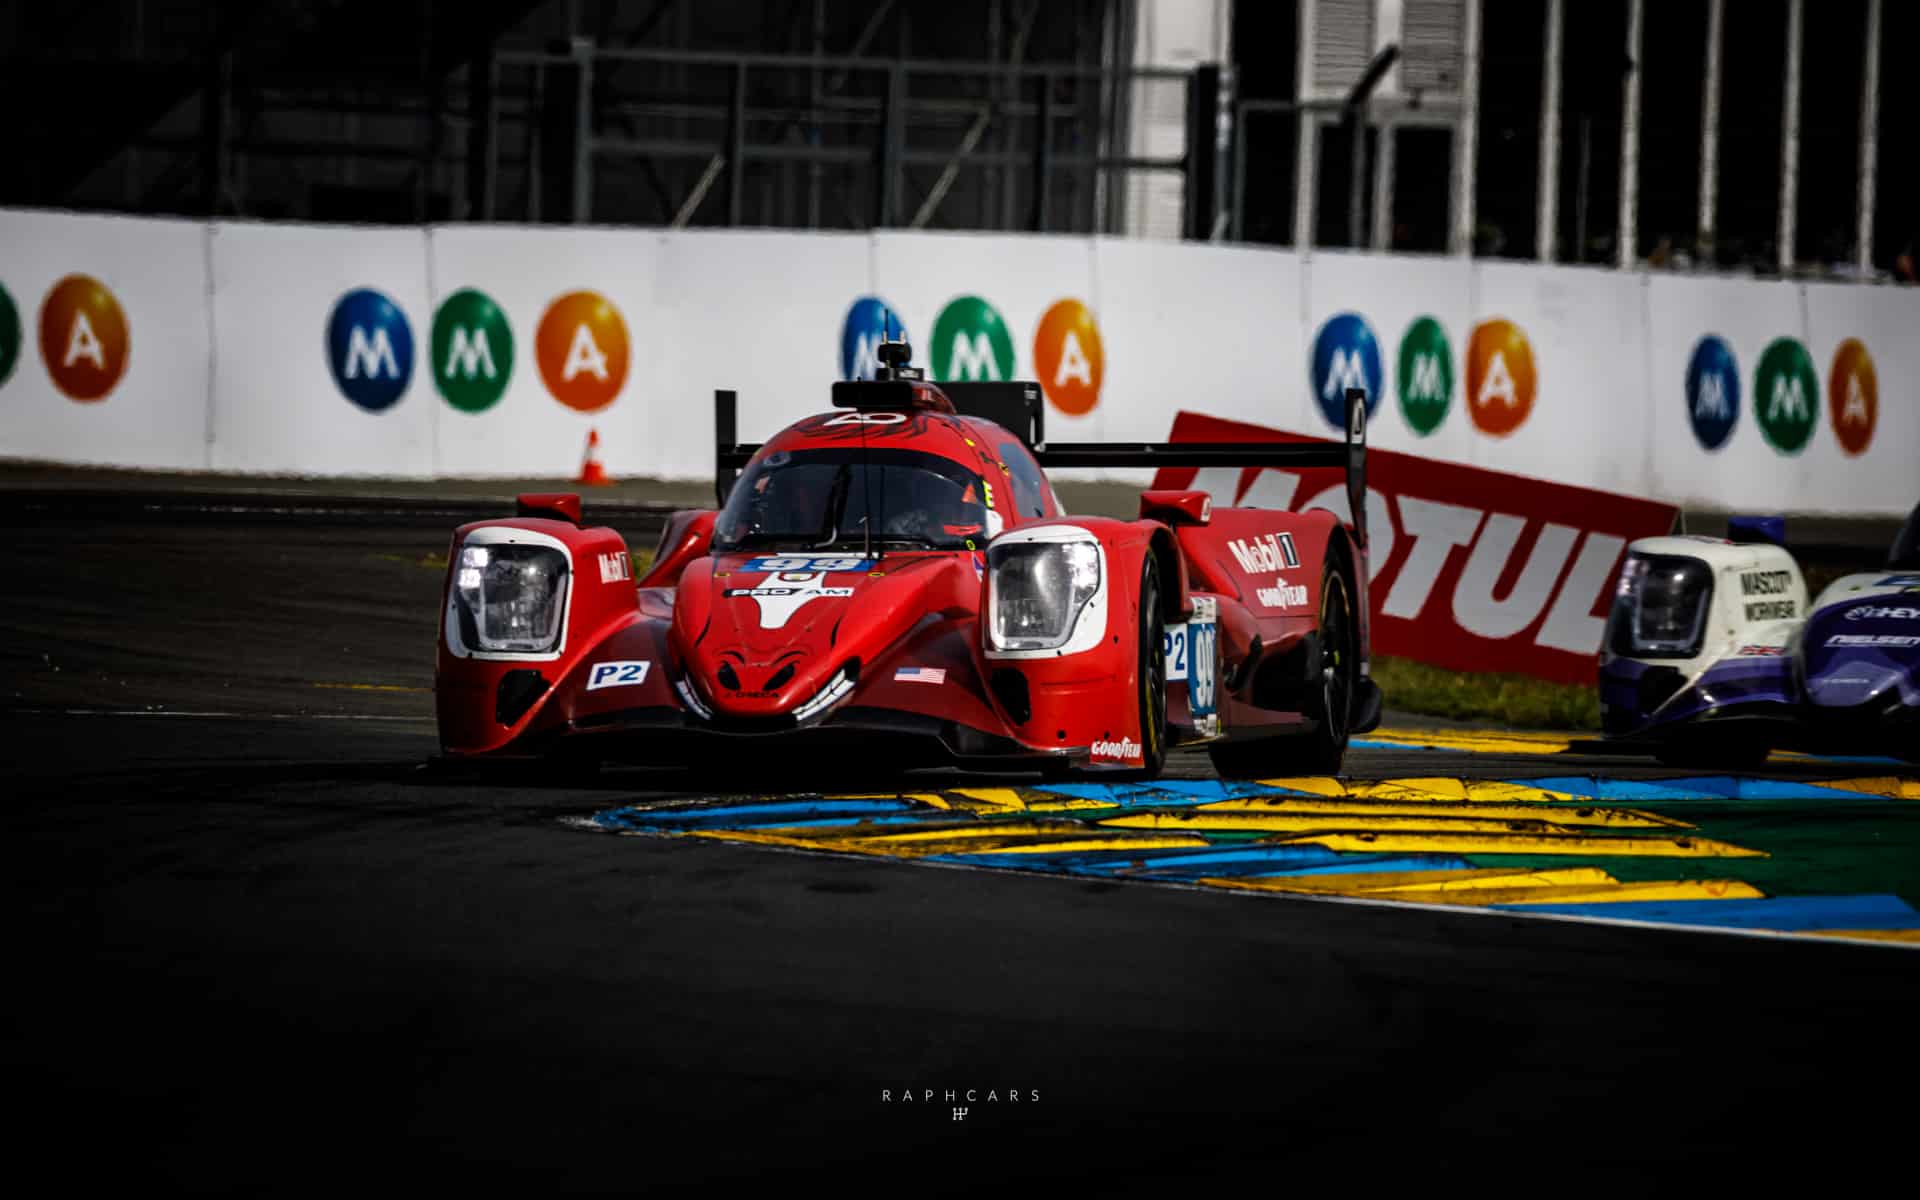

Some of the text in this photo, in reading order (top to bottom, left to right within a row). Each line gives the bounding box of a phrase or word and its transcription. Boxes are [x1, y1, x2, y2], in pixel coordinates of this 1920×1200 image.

[1227, 534, 1285, 574] Mobil
[757, 558, 862, 571] 99
[805, 588, 850, 596] AM
[594, 664, 643, 686] P2
